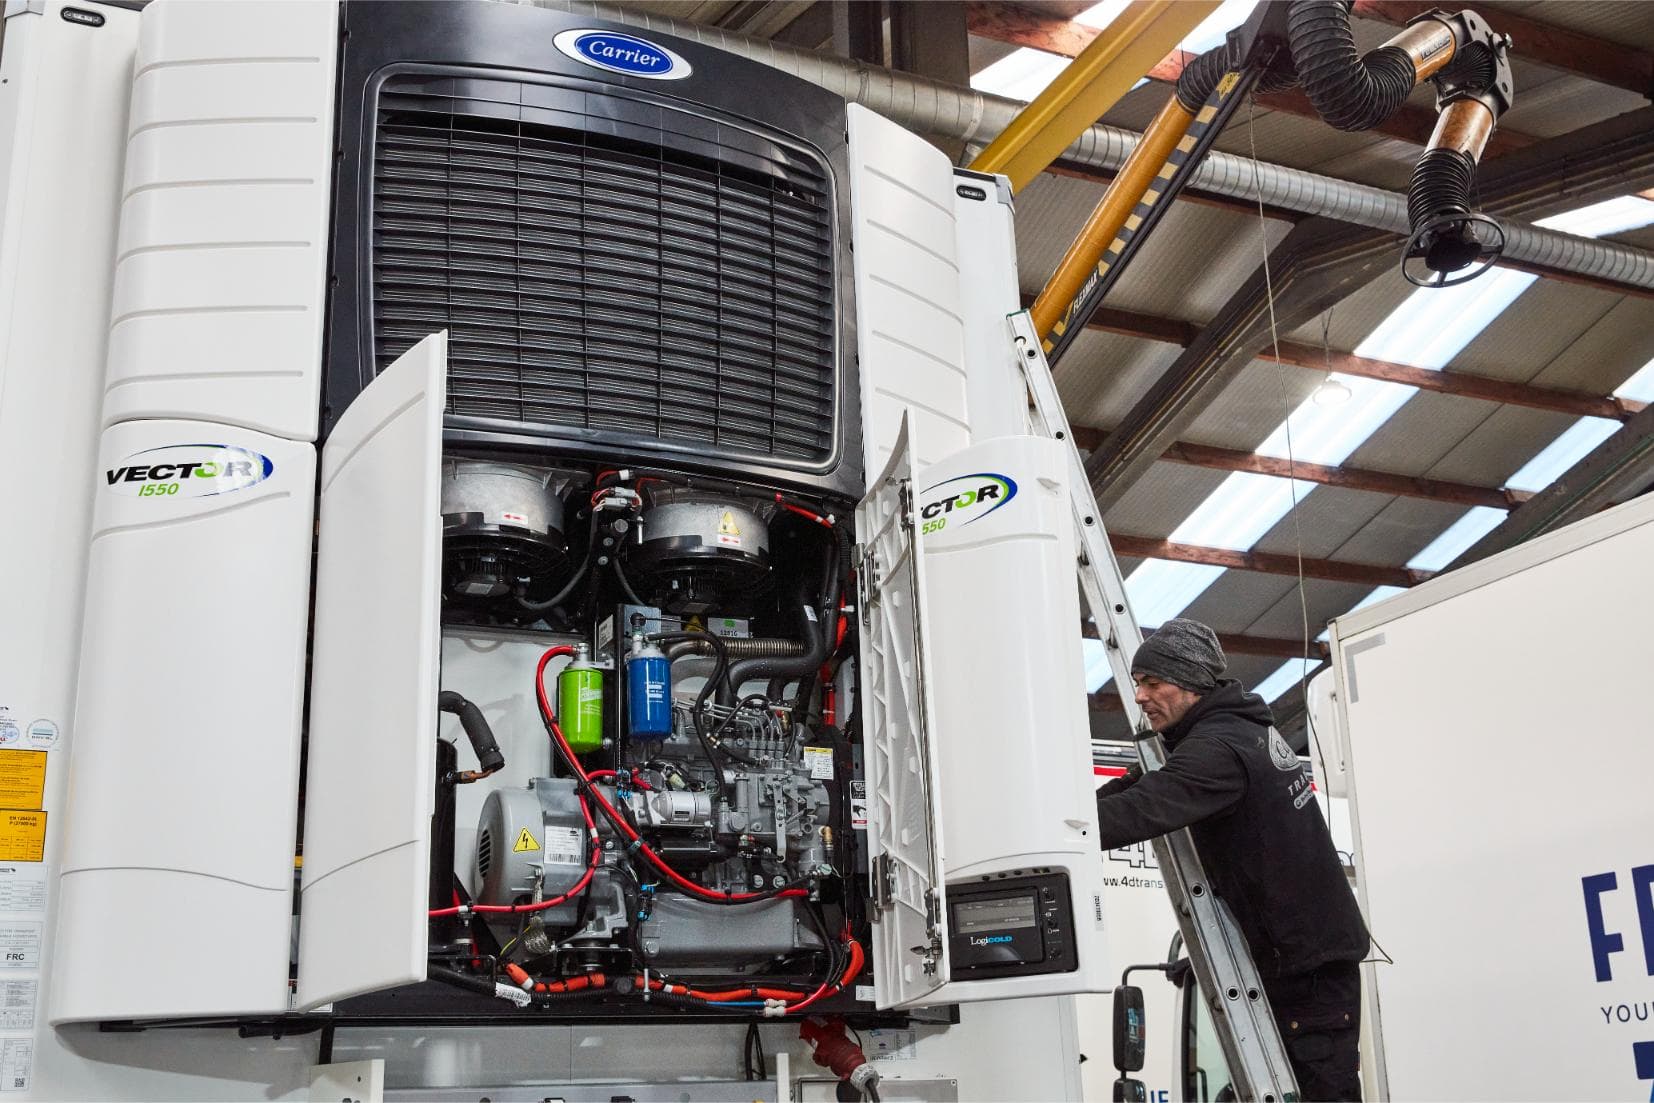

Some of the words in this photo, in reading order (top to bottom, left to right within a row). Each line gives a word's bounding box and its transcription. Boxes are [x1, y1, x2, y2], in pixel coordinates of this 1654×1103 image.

[589, 40, 661, 67] Carrier
[106, 461, 252, 486] VECTOR
[138, 483, 179, 497] 1550
[920, 484, 999, 520] CTOR
[970, 935, 1013, 947] LogiCOLD
[6, 953, 25, 961] FRC
[1600, 1001, 1654, 1024] YOU
